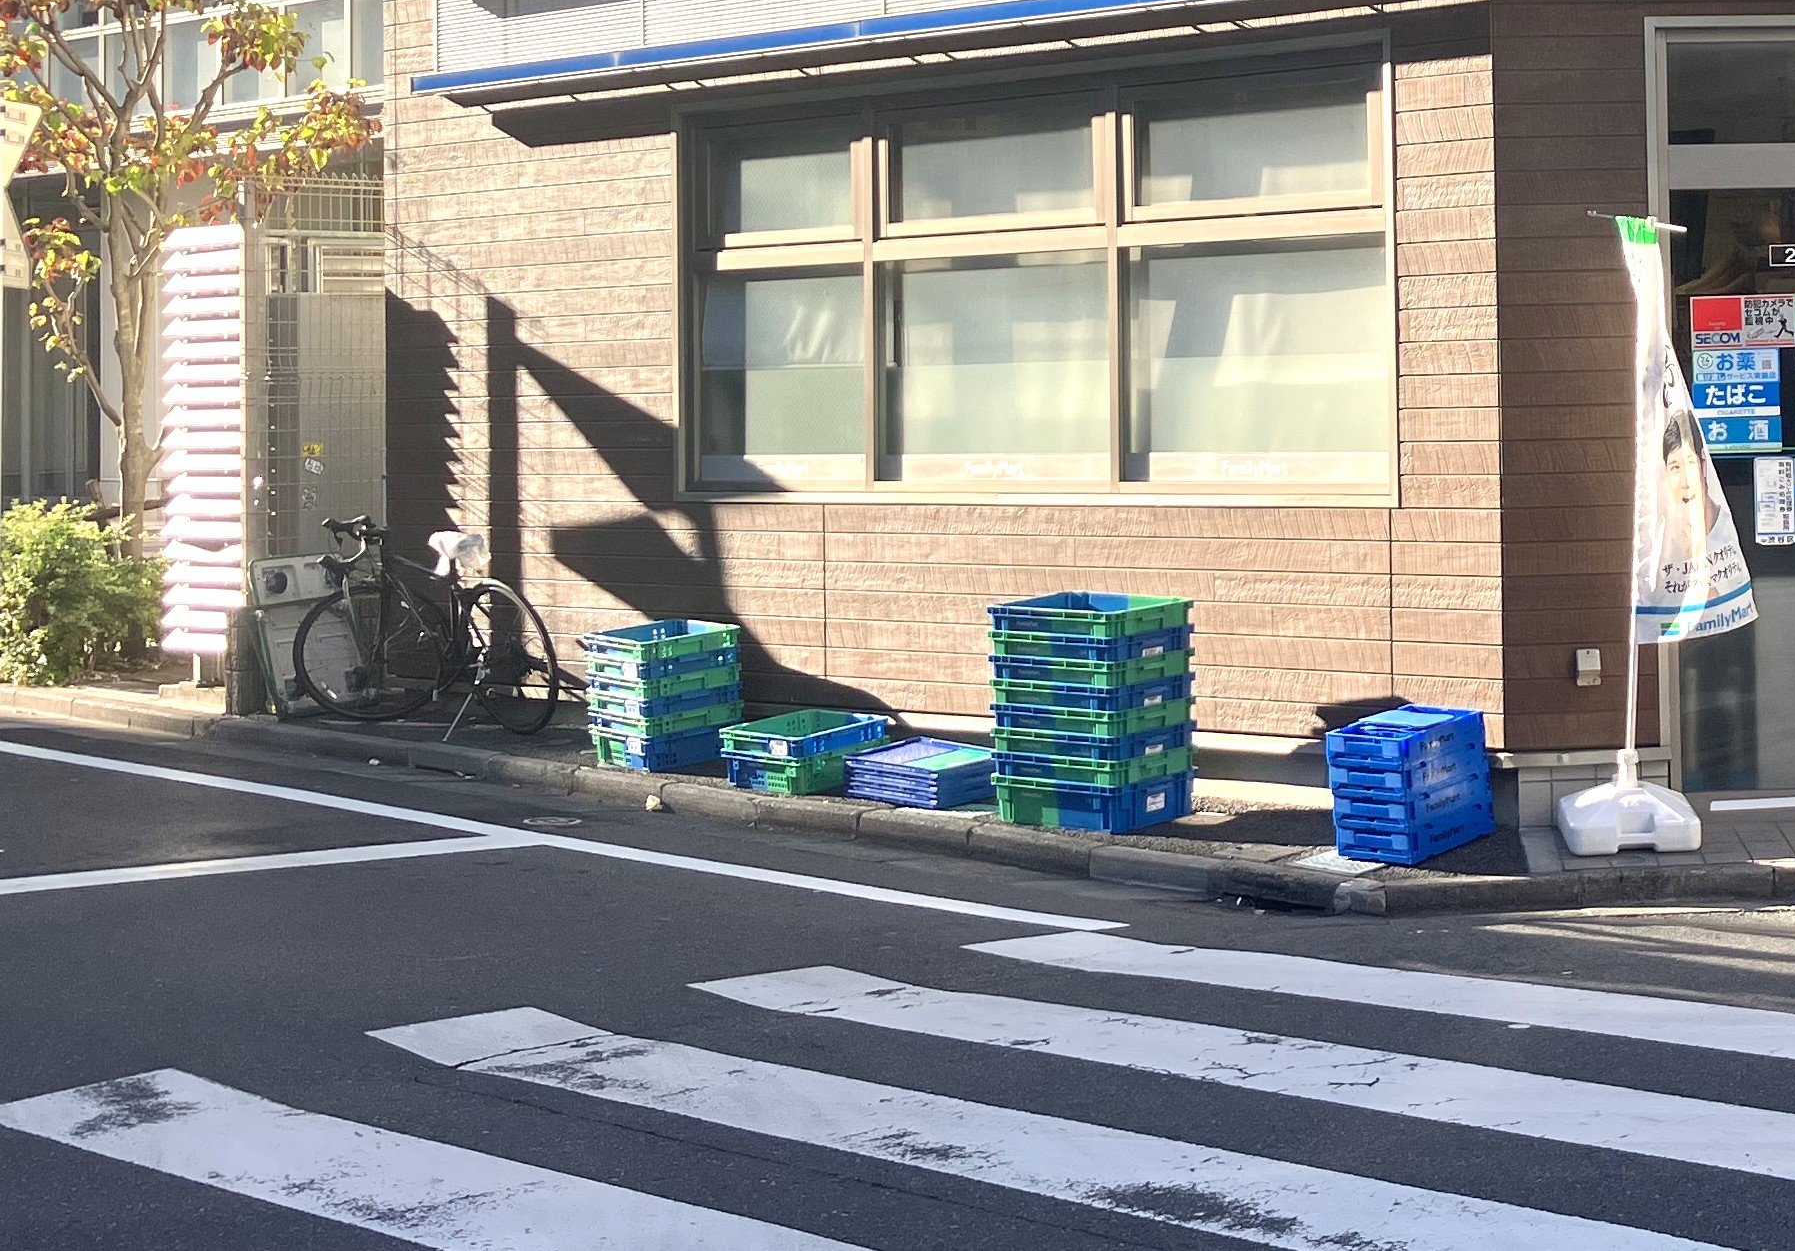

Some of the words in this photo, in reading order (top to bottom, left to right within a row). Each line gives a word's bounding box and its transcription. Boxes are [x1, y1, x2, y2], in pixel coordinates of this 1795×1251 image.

[1744, 308, 1780, 317] セコムが
[1695, 333, 1741, 345] SECOM
[1716, 352, 1757, 371] お薬
[1705, 384, 1766, 406] たばこ
[1707, 420, 1770, 442] お酒
